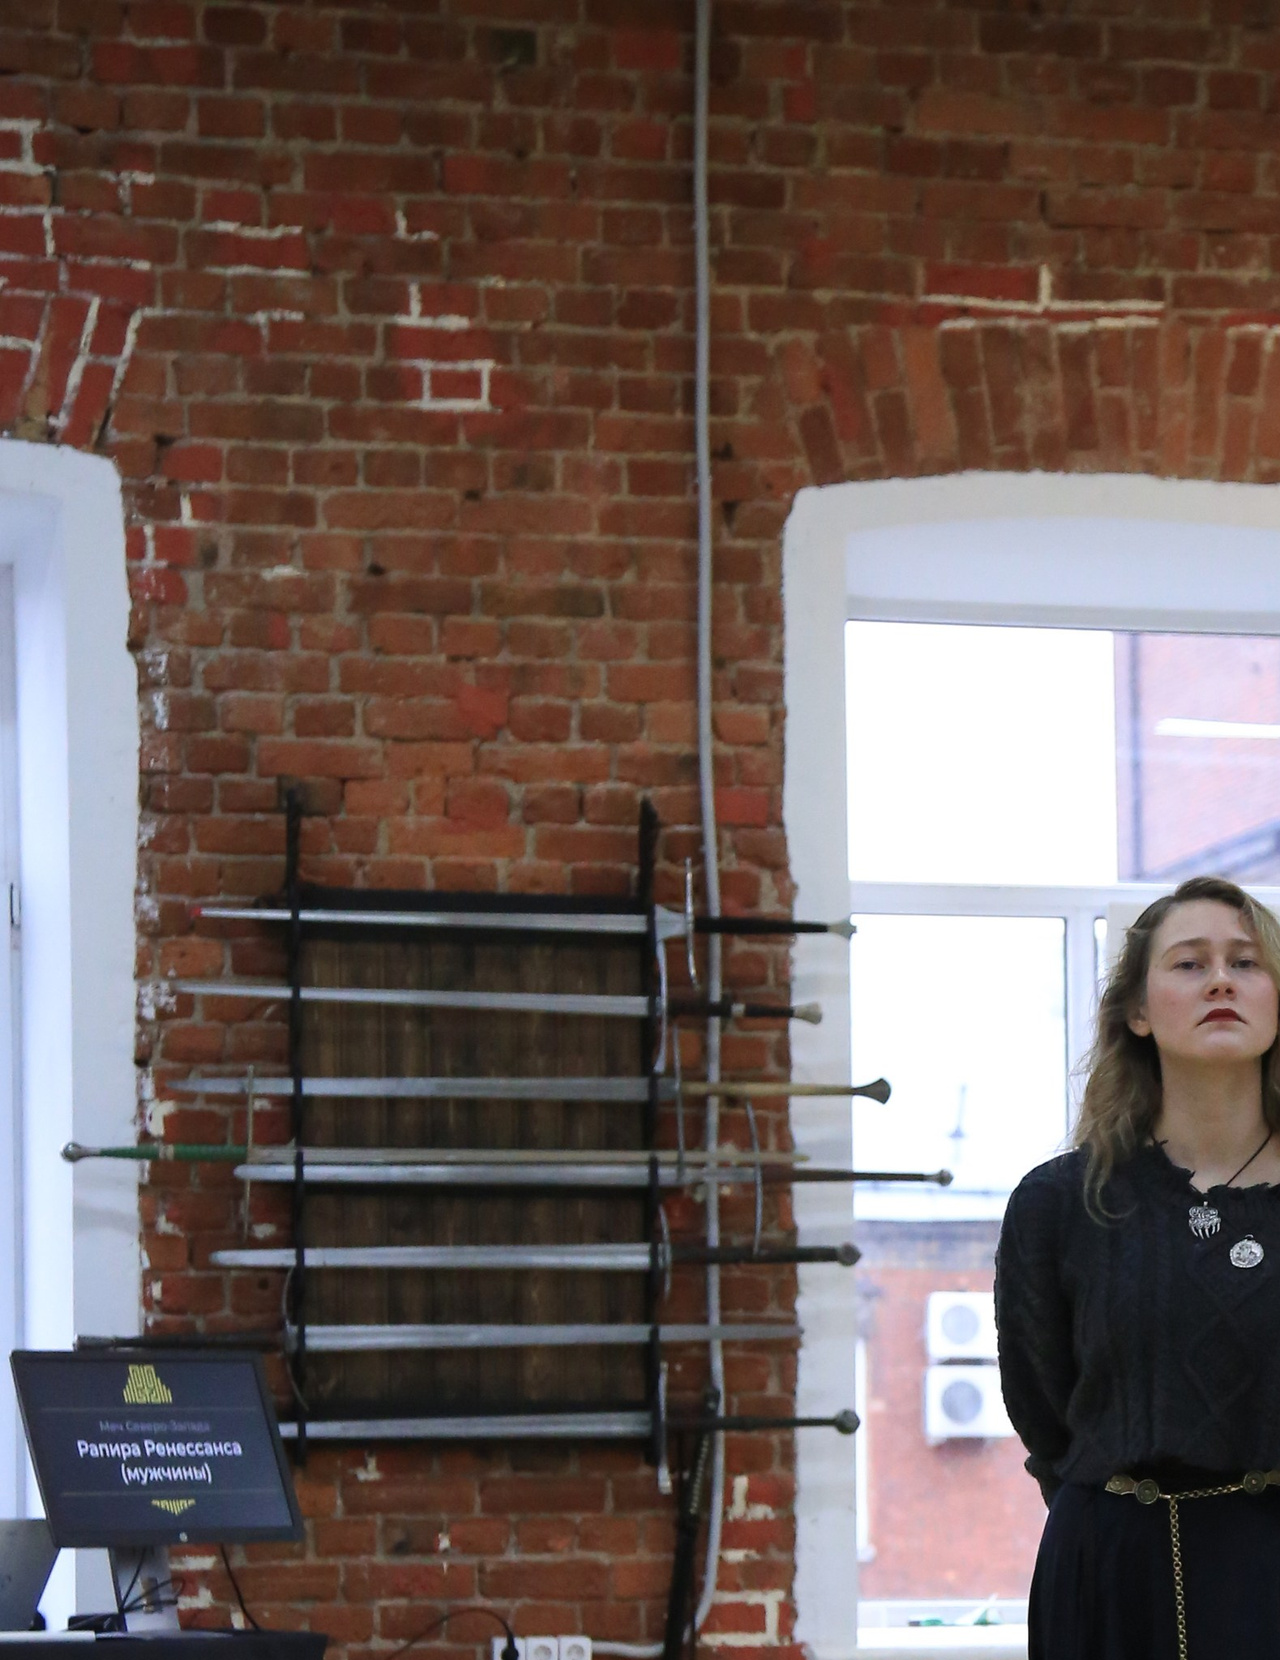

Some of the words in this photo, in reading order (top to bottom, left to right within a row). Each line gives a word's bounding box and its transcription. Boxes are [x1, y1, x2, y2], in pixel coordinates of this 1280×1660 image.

[77, 1438, 142, 1461] Рапира
[143, 1438, 243, 1457] Ренессанса
[121, 1461, 212, 1486] (мужчины)
